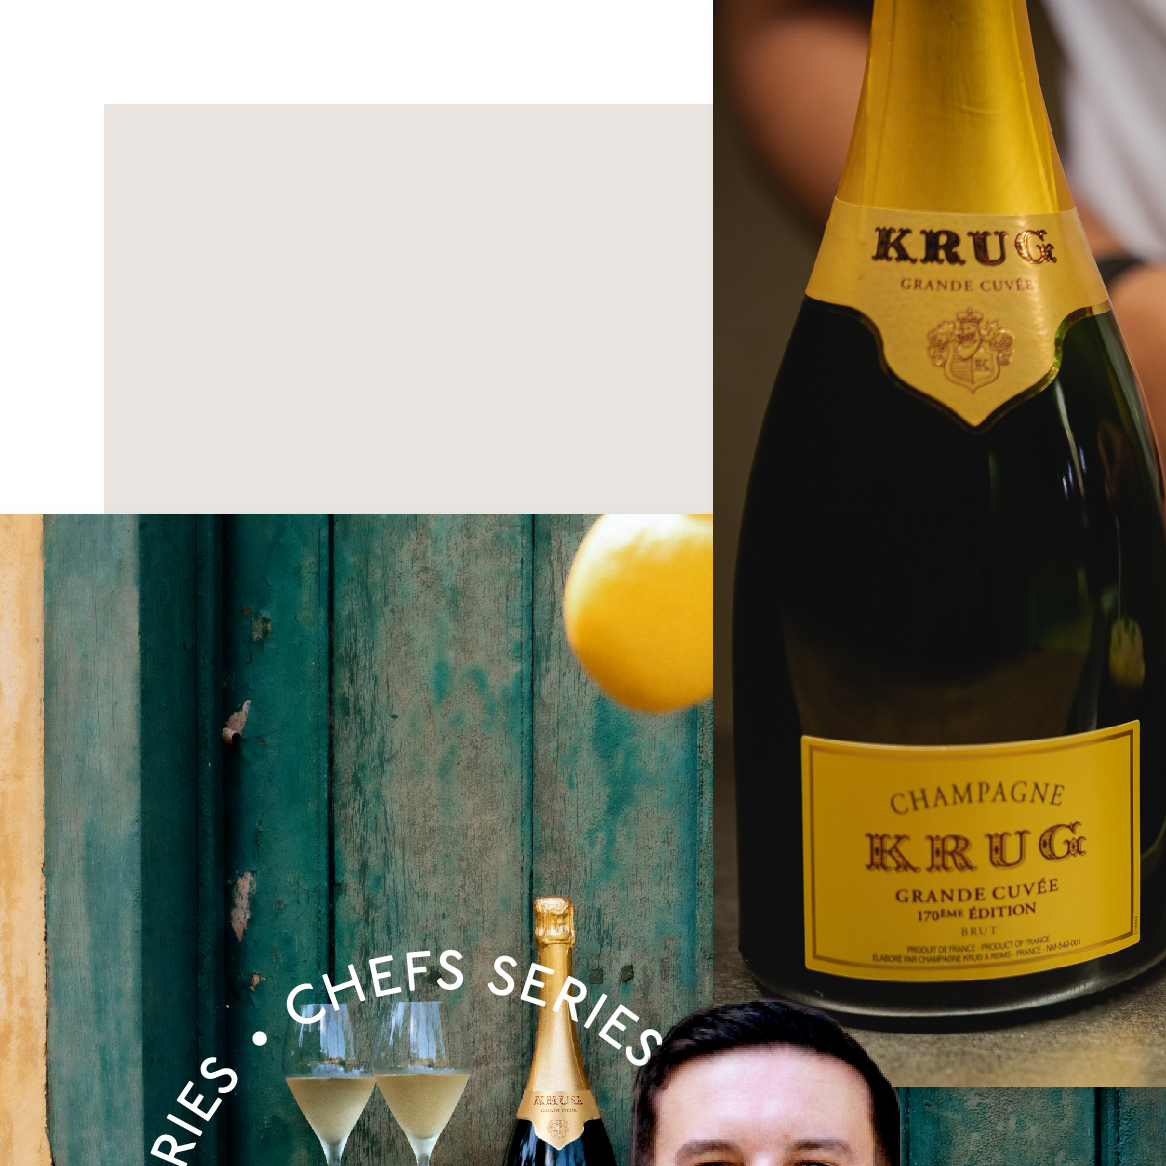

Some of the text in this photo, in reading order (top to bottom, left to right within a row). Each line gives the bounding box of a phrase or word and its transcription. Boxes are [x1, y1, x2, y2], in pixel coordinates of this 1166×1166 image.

[870, 226, 1058, 266] KRUG
[900, 276, 1035, 293] GRANDE CUVÉE
[890, 780, 1066, 815] CHAMPAGNE
[865, 821, 1088, 873] KRUG
[895, 877, 1060, 904] GRANDE CUVÉE
[968, 902, 1037, 921] ÉDITION
[960, 925, 999, 937] BRUT
[949, 943, 976, 953] FRANCE
[981, 940, 1013, 951] PRODUCT
[1025, 934, 1051, 946] FRANCE
[918, 953, 961, 964] CHAMPAGNE
[1016, 945, 1042, 957] FRANCE
